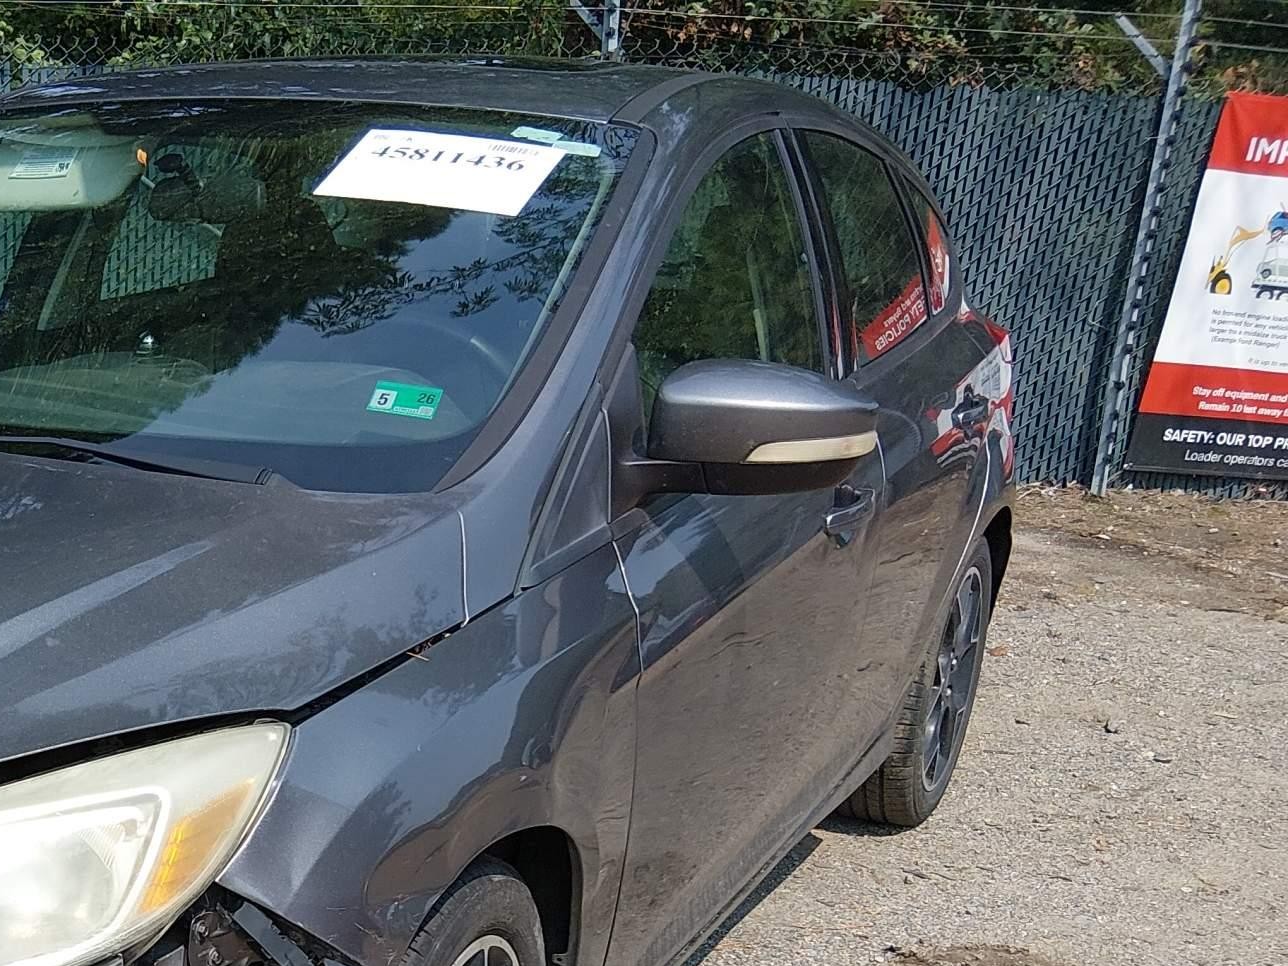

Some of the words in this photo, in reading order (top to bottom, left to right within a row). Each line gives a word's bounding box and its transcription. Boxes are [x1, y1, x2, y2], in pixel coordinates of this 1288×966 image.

[370, 145, 526, 172] 45811436
[1192, 385, 1212, 398] Stay
[1212, 387, 1225, 398] off
[377, 393, 391, 406] 5
[416, 393, 437, 406] 26
[1230, 403, 1243, 413] 10
[1163, 428, 1215, 445] SAFETY:
[1216, 431, 1246, 446] OUR
[1184, 449, 1224, 463] Loader
[1223, 453, 1276, 466] operators
